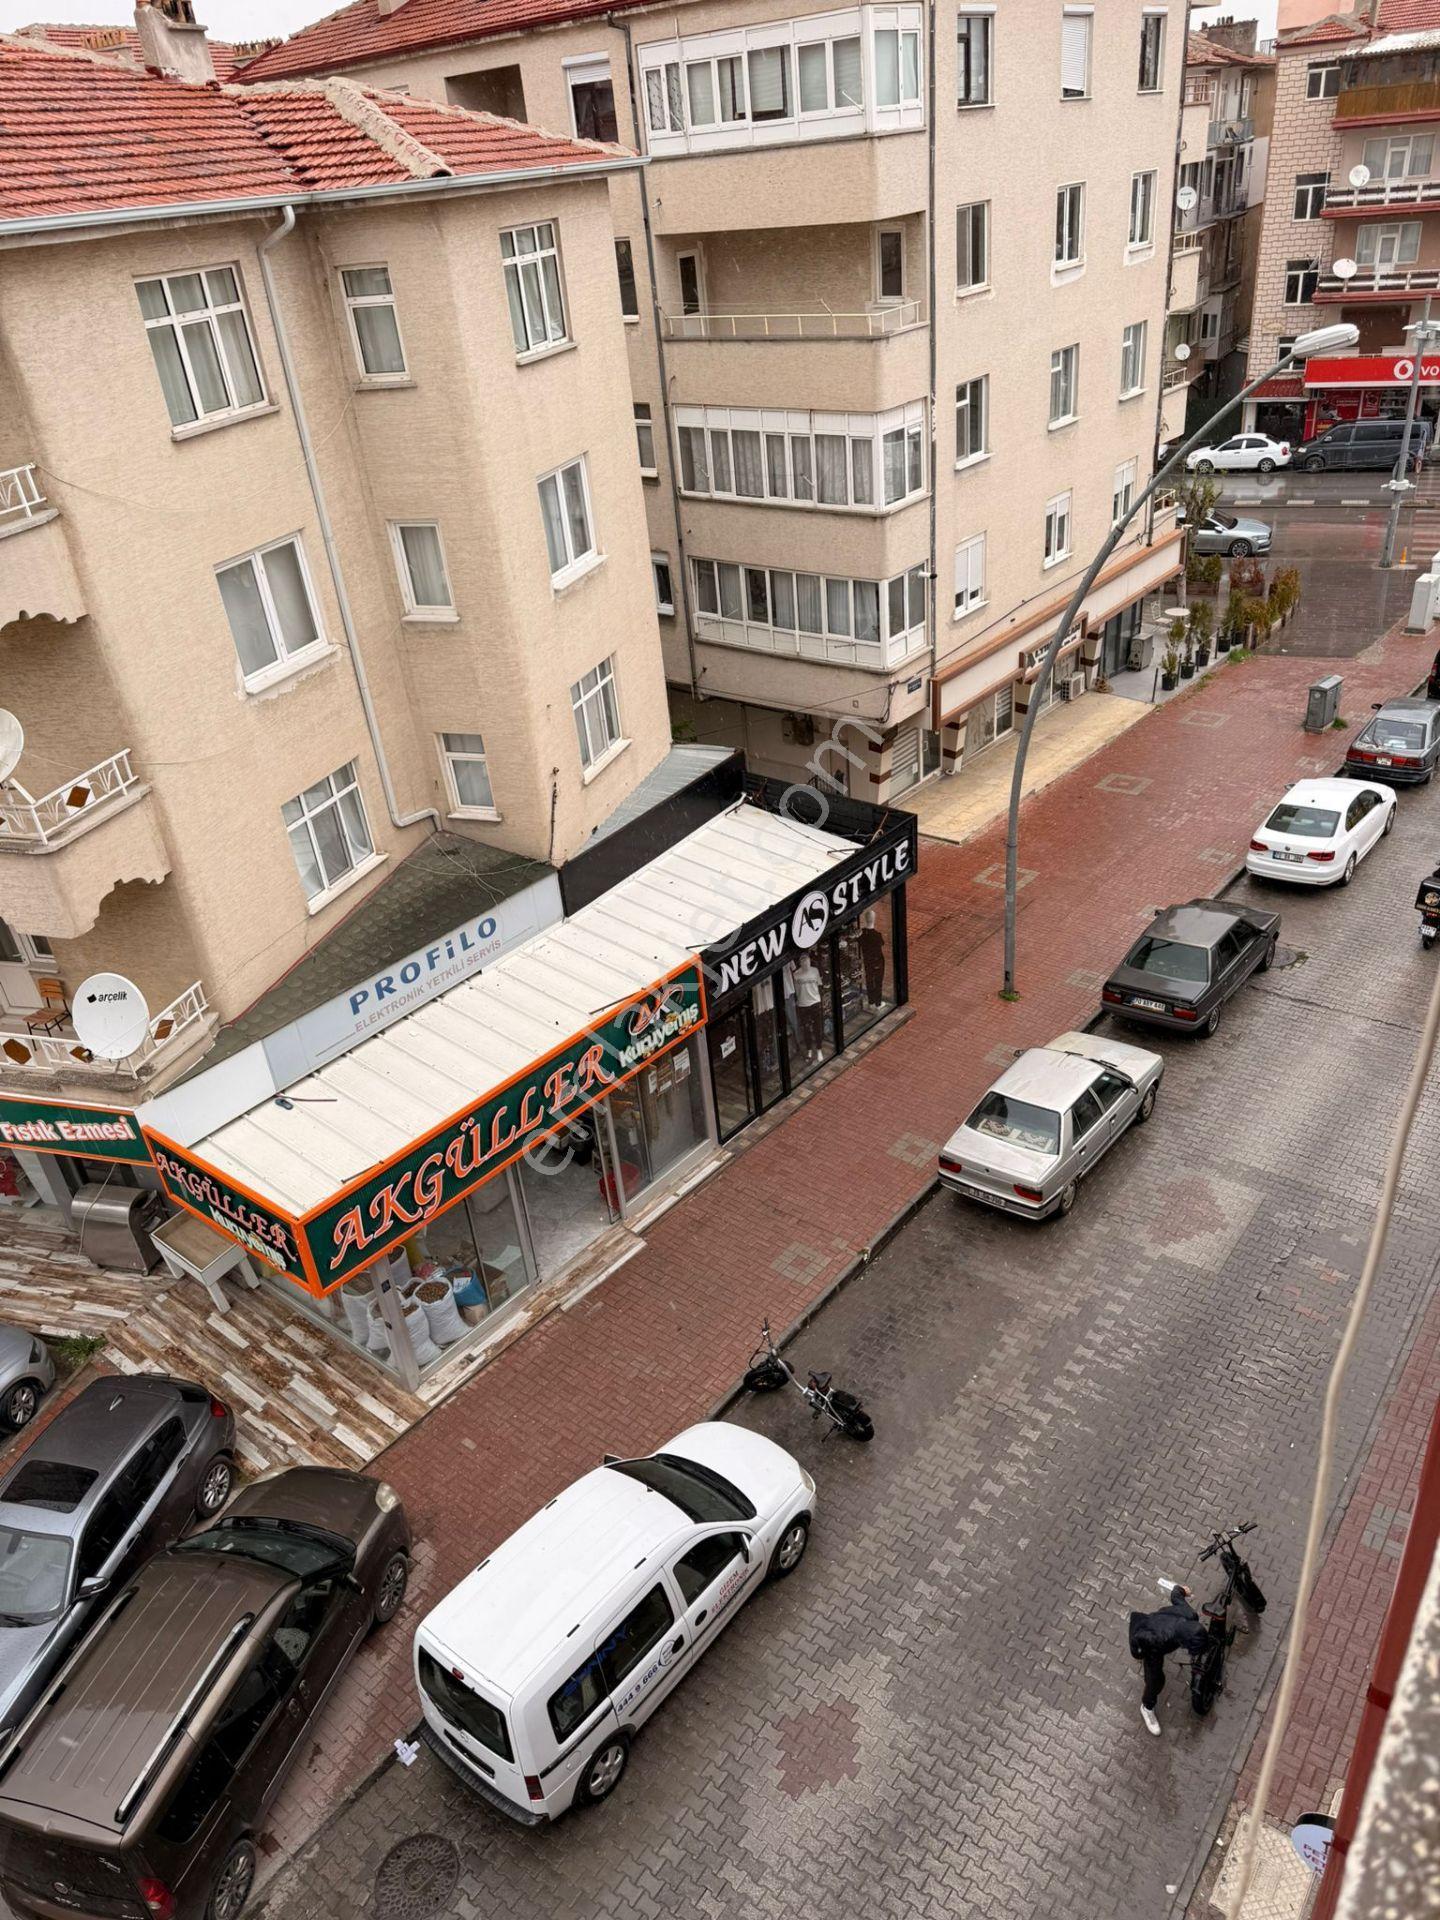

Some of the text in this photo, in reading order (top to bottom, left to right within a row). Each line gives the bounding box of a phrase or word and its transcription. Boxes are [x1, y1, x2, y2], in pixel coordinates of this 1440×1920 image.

[719, 921, 787, 994] NEW
[832, 839, 909, 916] STYLE
[98, 990, 128, 1004] arçelik
[54, 1115, 137, 1141] Ezmesi
[330, 1043, 616, 1271] AKGÜLLER
[156, 1151, 298, 1263] AKGÜLLER
